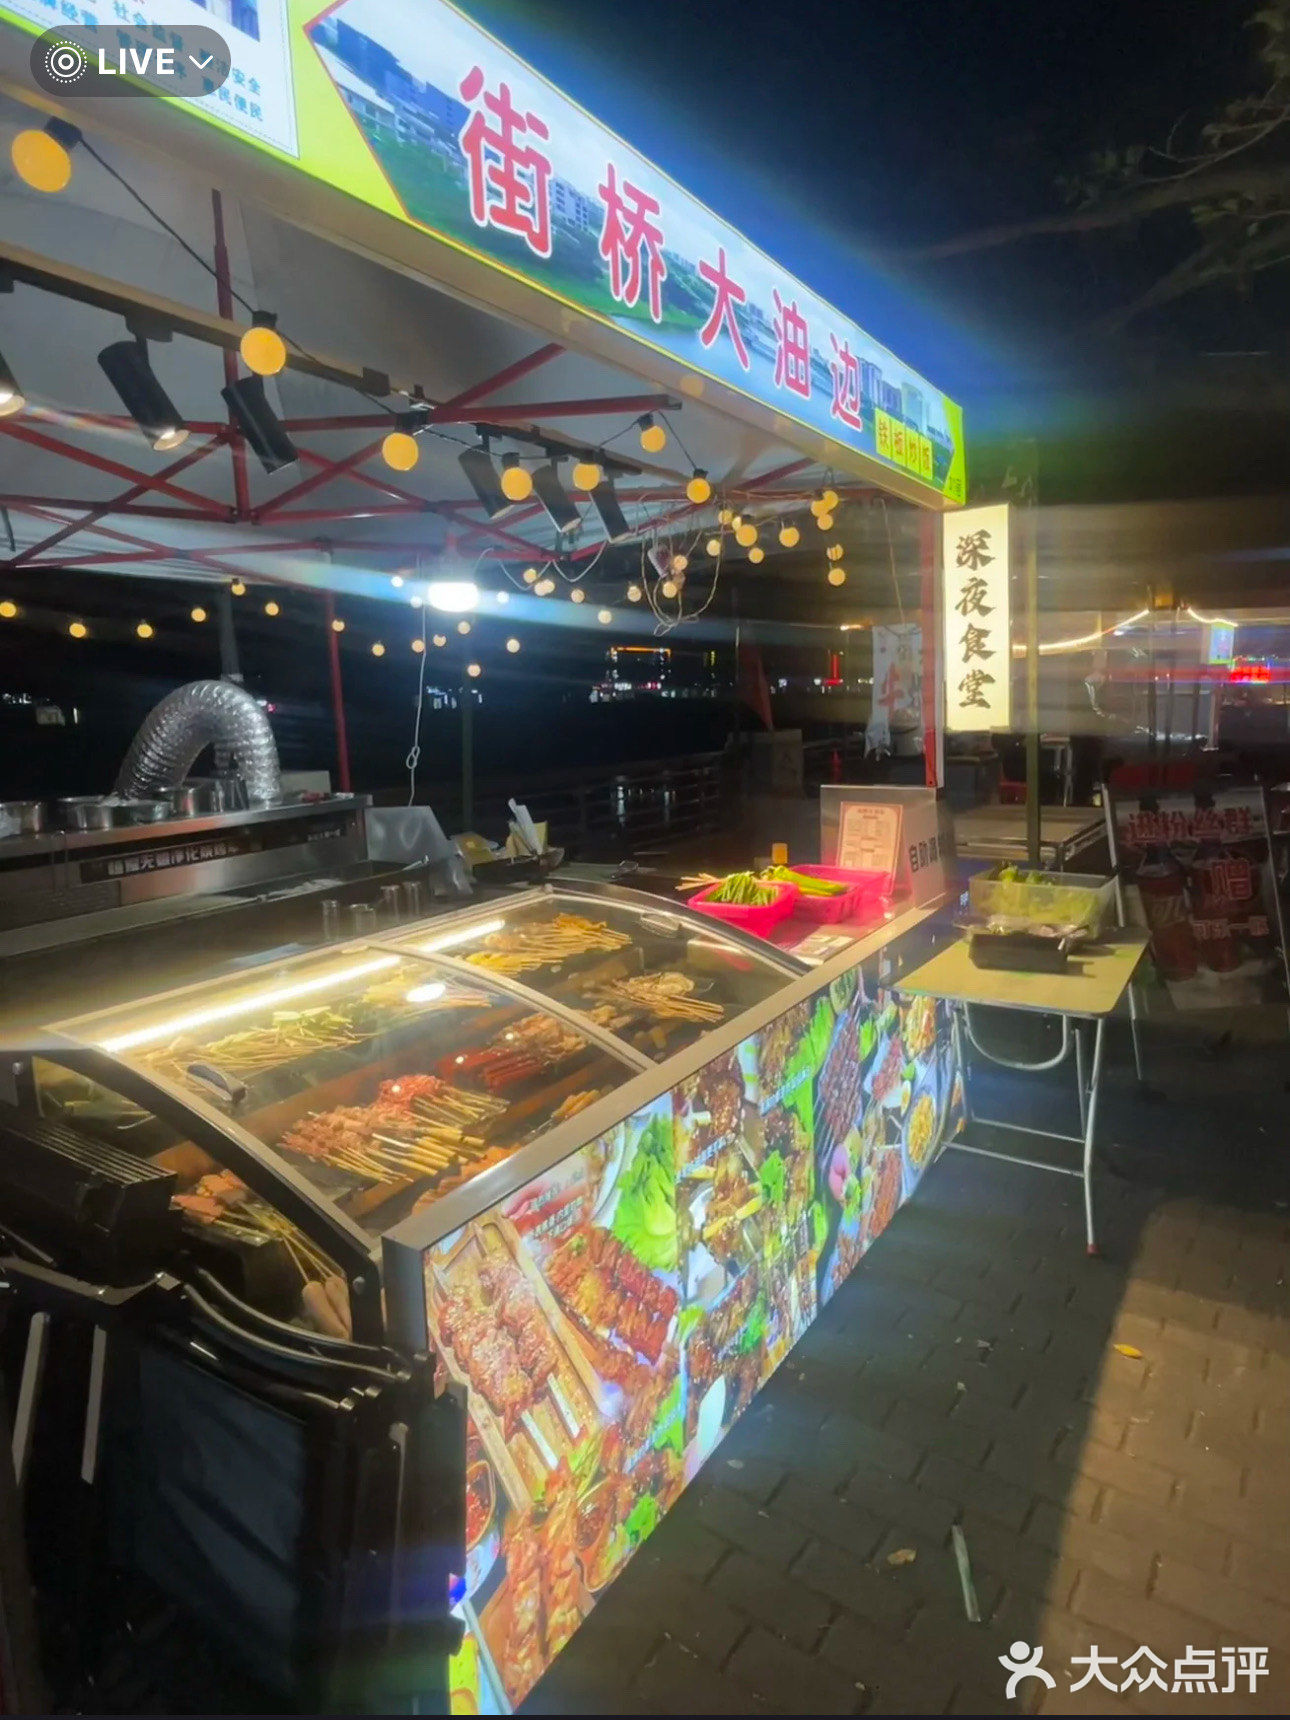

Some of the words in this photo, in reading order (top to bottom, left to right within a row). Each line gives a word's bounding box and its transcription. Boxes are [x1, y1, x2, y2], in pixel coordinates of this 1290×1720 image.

[459, 66, 863, 431] 街桥大油边
[954, 528, 997, 710] 深夜食堂
